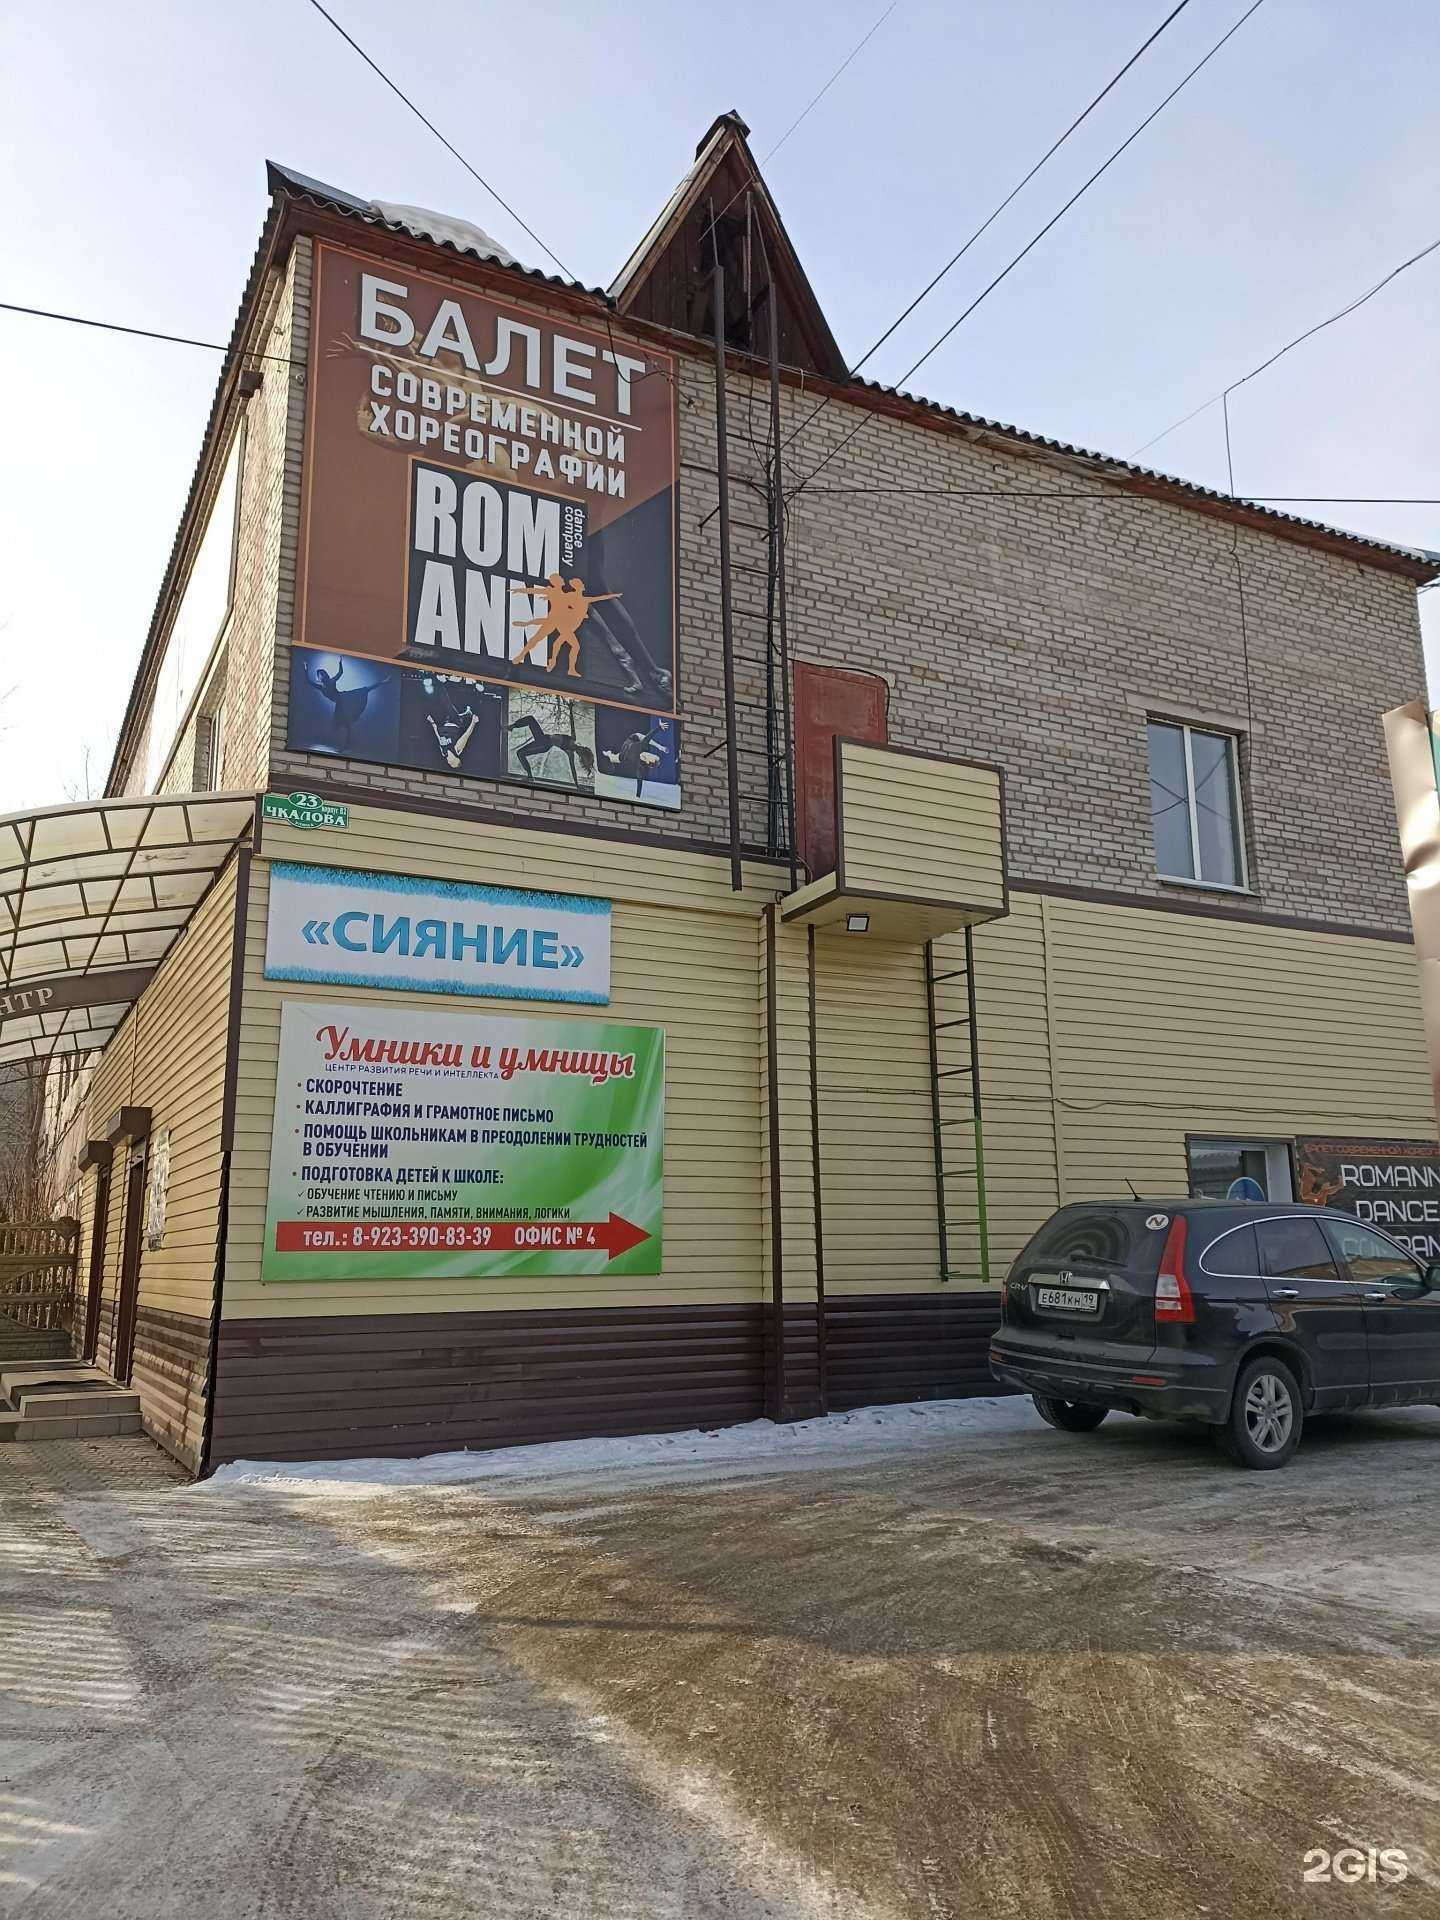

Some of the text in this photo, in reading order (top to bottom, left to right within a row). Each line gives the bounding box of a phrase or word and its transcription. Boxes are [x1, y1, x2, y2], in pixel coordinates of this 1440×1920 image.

[360, 272, 646, 415] БАЛЕТ
[370, 364, 626, 463] СОВРЕМЕННОЙ
[369, 401, 626, 498] ХОРЕОГРАФИИ
[415, 467, 560, 580] ROM
[573, 508, 586, 548] dance
[561, 505, 575, 567] company
[414, 559, 549, 667] ANN
[296, 793, 318, 807] 23
[266, 805, 345, 826] ЧКАЛОВА
[301, 911, 585, 970] «СИЯНИЕ»
[316, 1025, 634, 1084] Умники и умницы
[325, 1063, 499, 1079] ЦЕНТР РАЗВИТИЯ РЕЧИ И ИНТЕЛЛЕКТА
[306, 1078, 403, 1097] СКОРОЧТЕНИЕ
[305, 1099, 554, 1123] КАЛЛИГРАФИЯ И ГРАМОТНОЕ ПИСЬМО
[303, 1123, 648, 1149] ПОМОЩЬ ШКОЛЬНИКАМ В ПРЕОДОЛЕНИИ ТРУДНОСТЕЙ
[303, 1142, 389, 1158] В ОБУЧЕНИИ
[301, 1165, 504, 1185] ПОДГОТОВКА ДЕТЕЙ К ШКОЛЕ:
[1340, 1164, 1440, 1188] ROMANN
[307, 1187, 458, 1201] ОБУЧЕНИЕ ЧТЕНИЮ И ПИСЬМУ
[306, 1206, 570, 1220] РАЗВИТИЕ МЫШЛЕНИЯ, ПАМЯТИ, ВНИМАНИЯ, ЛОГИКИ
[1355, 1200, 1440, 1222] DANCE
[303, 1225, 596, 1246] тел.: 8-923-390-83-39 ОФИС № 4
